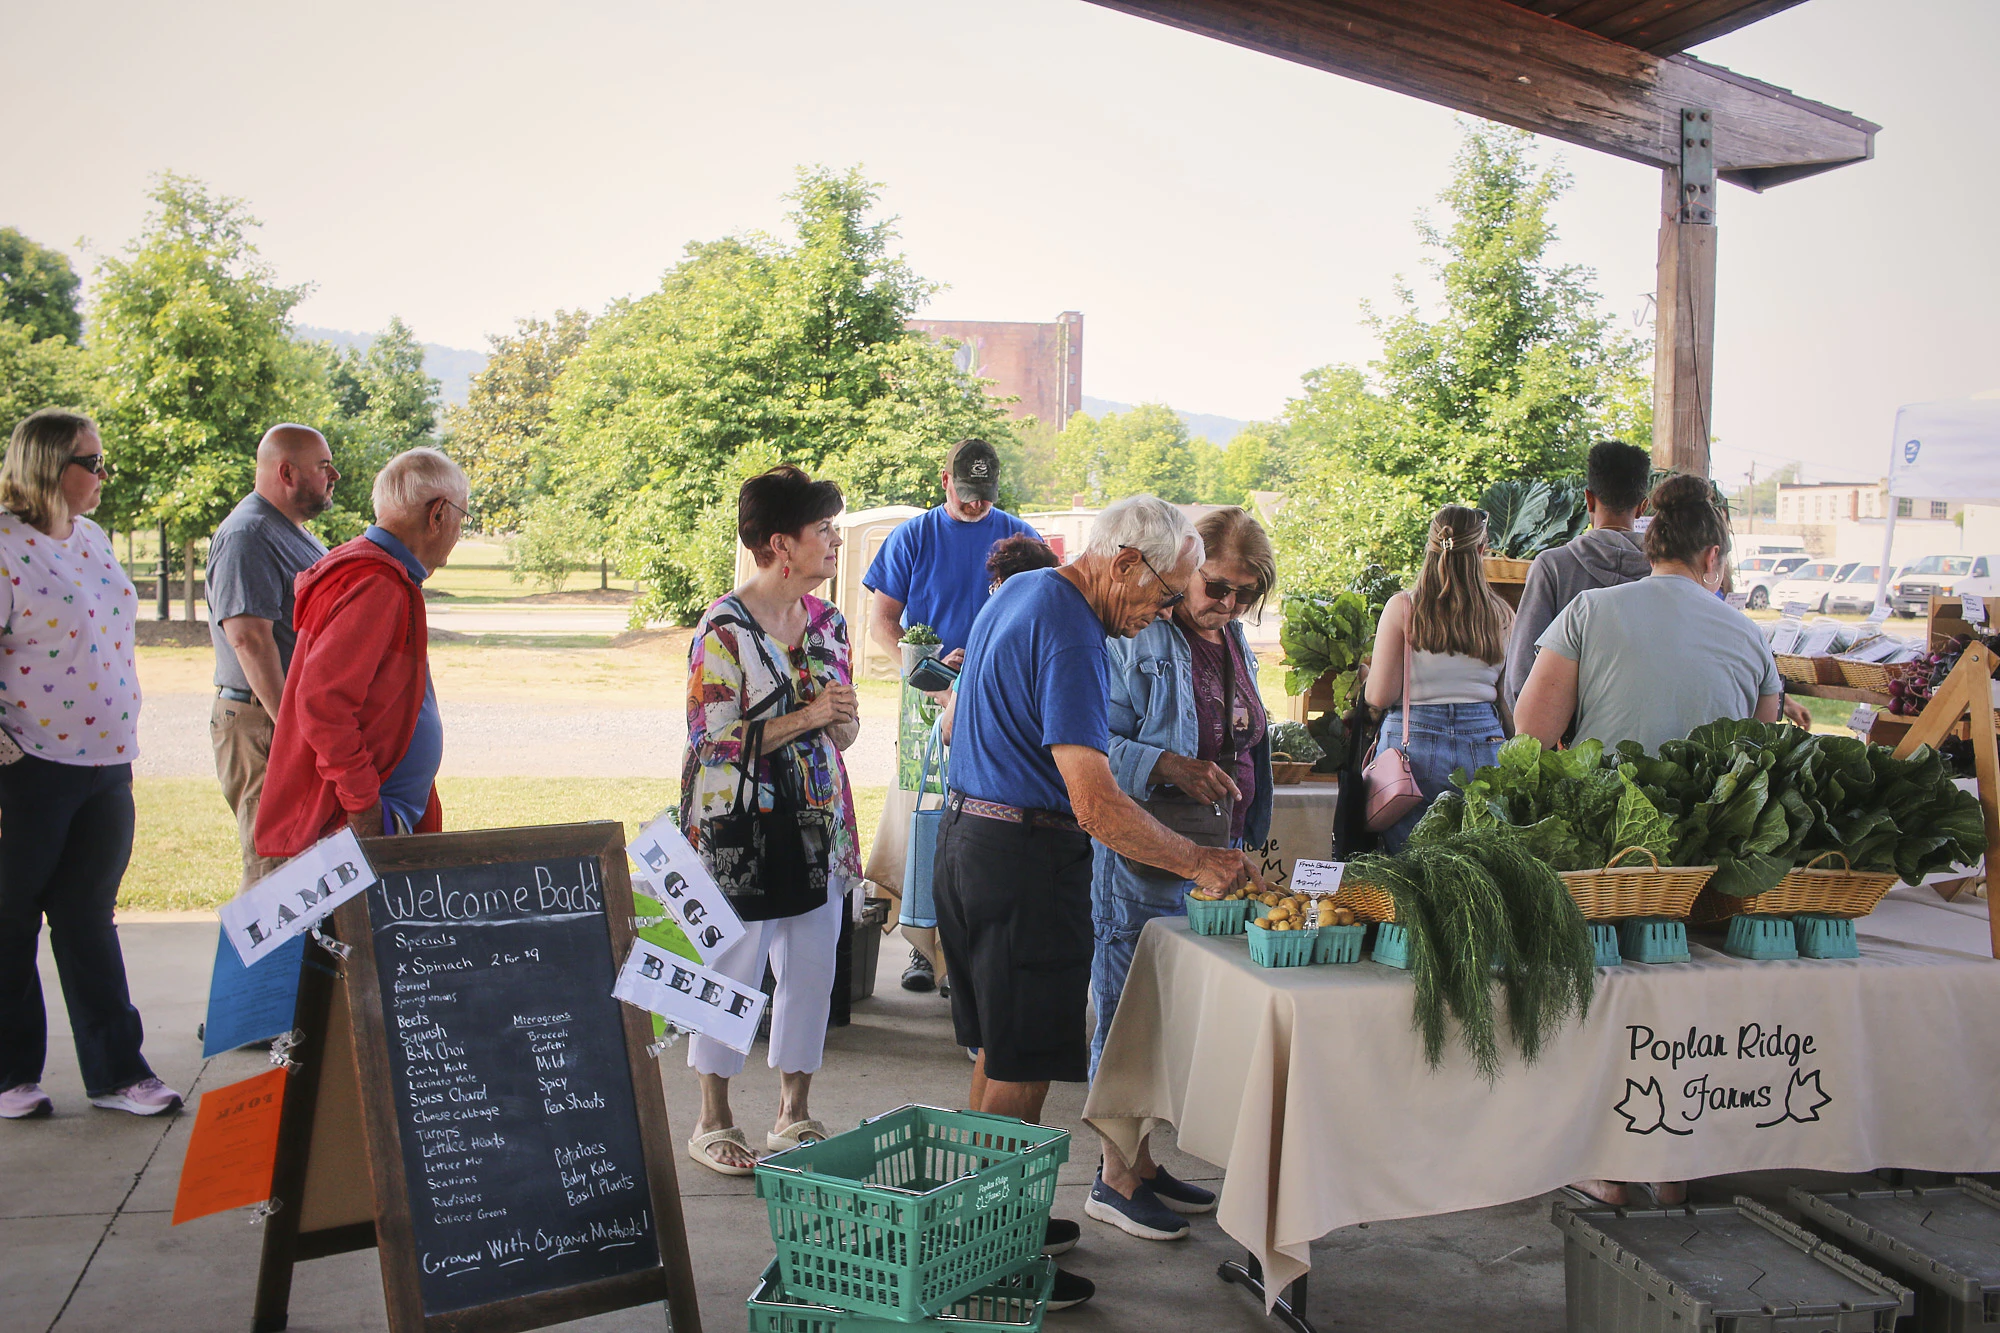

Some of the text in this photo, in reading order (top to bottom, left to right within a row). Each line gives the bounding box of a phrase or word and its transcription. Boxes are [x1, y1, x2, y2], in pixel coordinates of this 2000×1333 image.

[381, 861, 601, 920] Welcome Back!
[640, 839, 724, 948] EGGS
[243, 861, 359, 949] LAMB
[395, 932, 457, 951] Specials
[412, 957, 473, 975] Spinach
[491, 953, 500, 966] 2
[504, 953, 520, 963] for
[637, 952, 754, 1019] BEEF
[397, 1011, 429, 1028] Beets
[513, 1012, 571, 1026] Microgreens
[400, 1022, 447, 1048] Squash
[527, 1028, 568, 1041] Broccoli
[406, 1041, 465, 1061] Bok Choi
[531, 1041, 566, 1053] Confetti
[1626, 1023, 1817, 1070] Poplar Ridge
[406, 1061, 468, 1077] Curly Kale
[535, 1053, 565, 1071] Mild
[409, 1074, 477, 1090] Lacinato Kale
[538, 1077, 567, 1095] Spicy
[410, 1083, 488, 1107] Swiss Chard
[544, 1091, 605, 1115] Pea Shoots
[1681, 1073, 1772, 1122] Farms
[413, 1110, 450, 1124] Chinese
[416, 1127, 460, 1142] Turnips
[422, 1132, 505, 1158] Lettuce Heads
[554, 1141, 607, 1169] Potatoes
[425, 1156, 483, 1173] Lettuce Mix
[560, 1159, 616, 1188] Baby Kale
[427, 1175, 478, 1190] Scallions
[567, 1172, 634, 1206] Basil Plants
[432, 1193, 482, 1207] Radishes
[434, 1207, 507, 1224] Collard Greens
[422, 1251, 483, 1275] Grown
[486, 1230, 530, 1261] With
[534, 1228, 588, 1255] Organic
